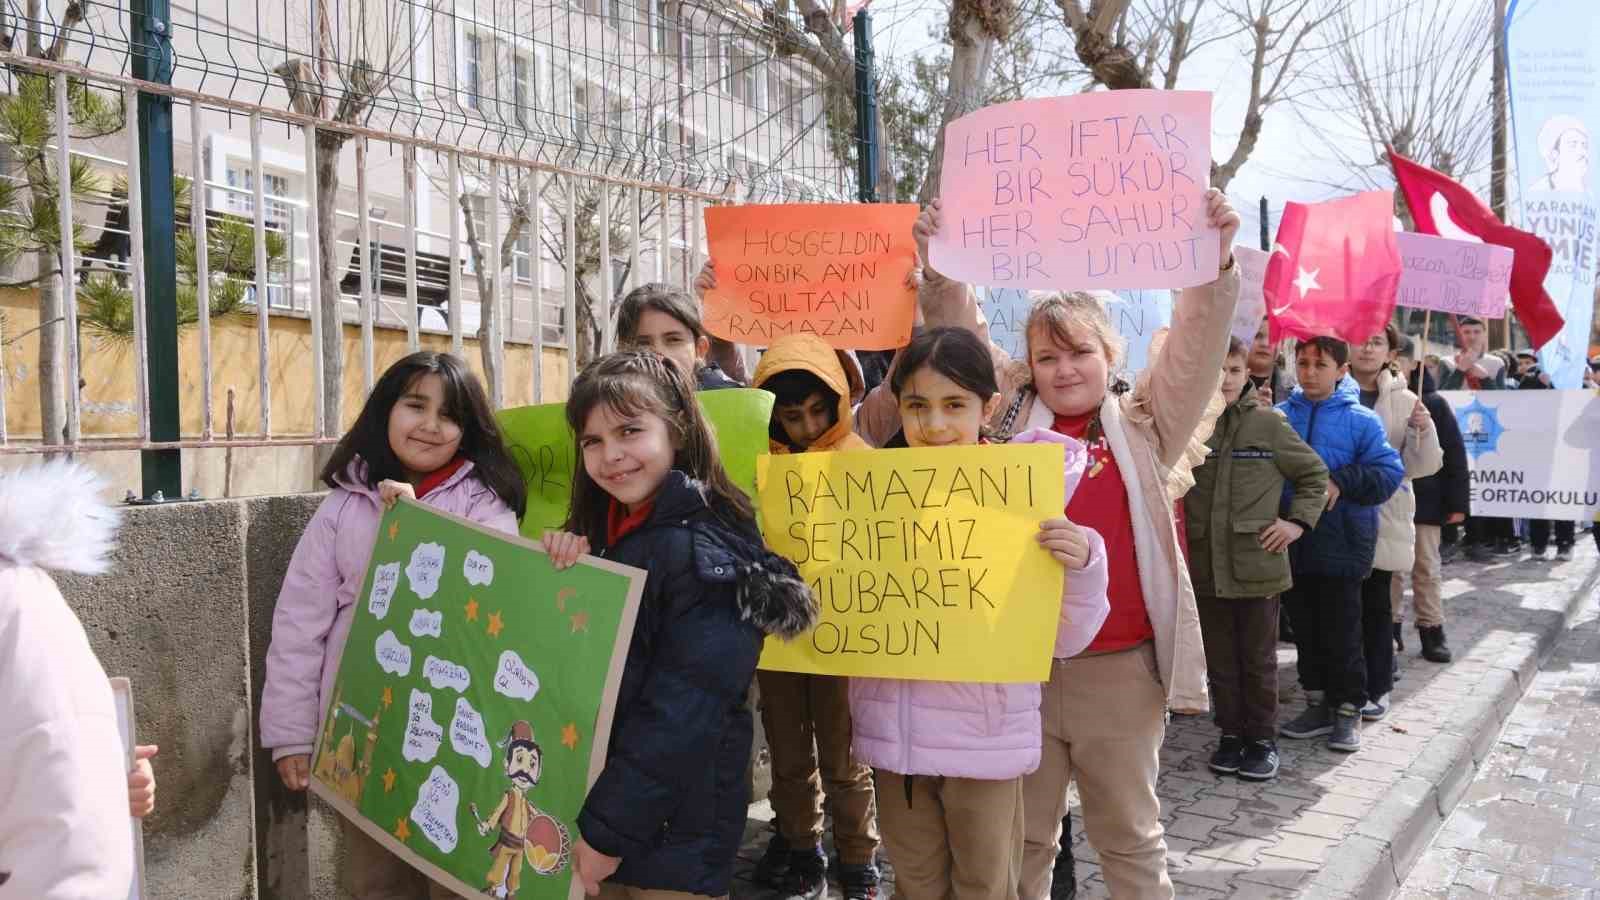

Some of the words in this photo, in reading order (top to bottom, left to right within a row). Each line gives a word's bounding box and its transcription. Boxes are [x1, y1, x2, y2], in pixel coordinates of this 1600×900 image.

[964, 122, 1042, 168] HER
[994, 167, 1052, 206] BIR
[962, 210, 1038, 249] HER
[1057, 195, 1194, 243] SAHUR
[1528, 216, 1595, 242] YUNUS
[992, 251, 1052, 281] BIR
[1087, 237, 1203, 278] UMUT
[822, 262, 877, 284] AYIN
[749, 290, 871, 314] SULTANI
[729, 315, 875, 338] RAMAZAN
[1469, 470, 1524, 485] AMAN
[1481, 488, 1598, 506] ORTAOKULU
[812, 619, 941, 656] OLSUN
